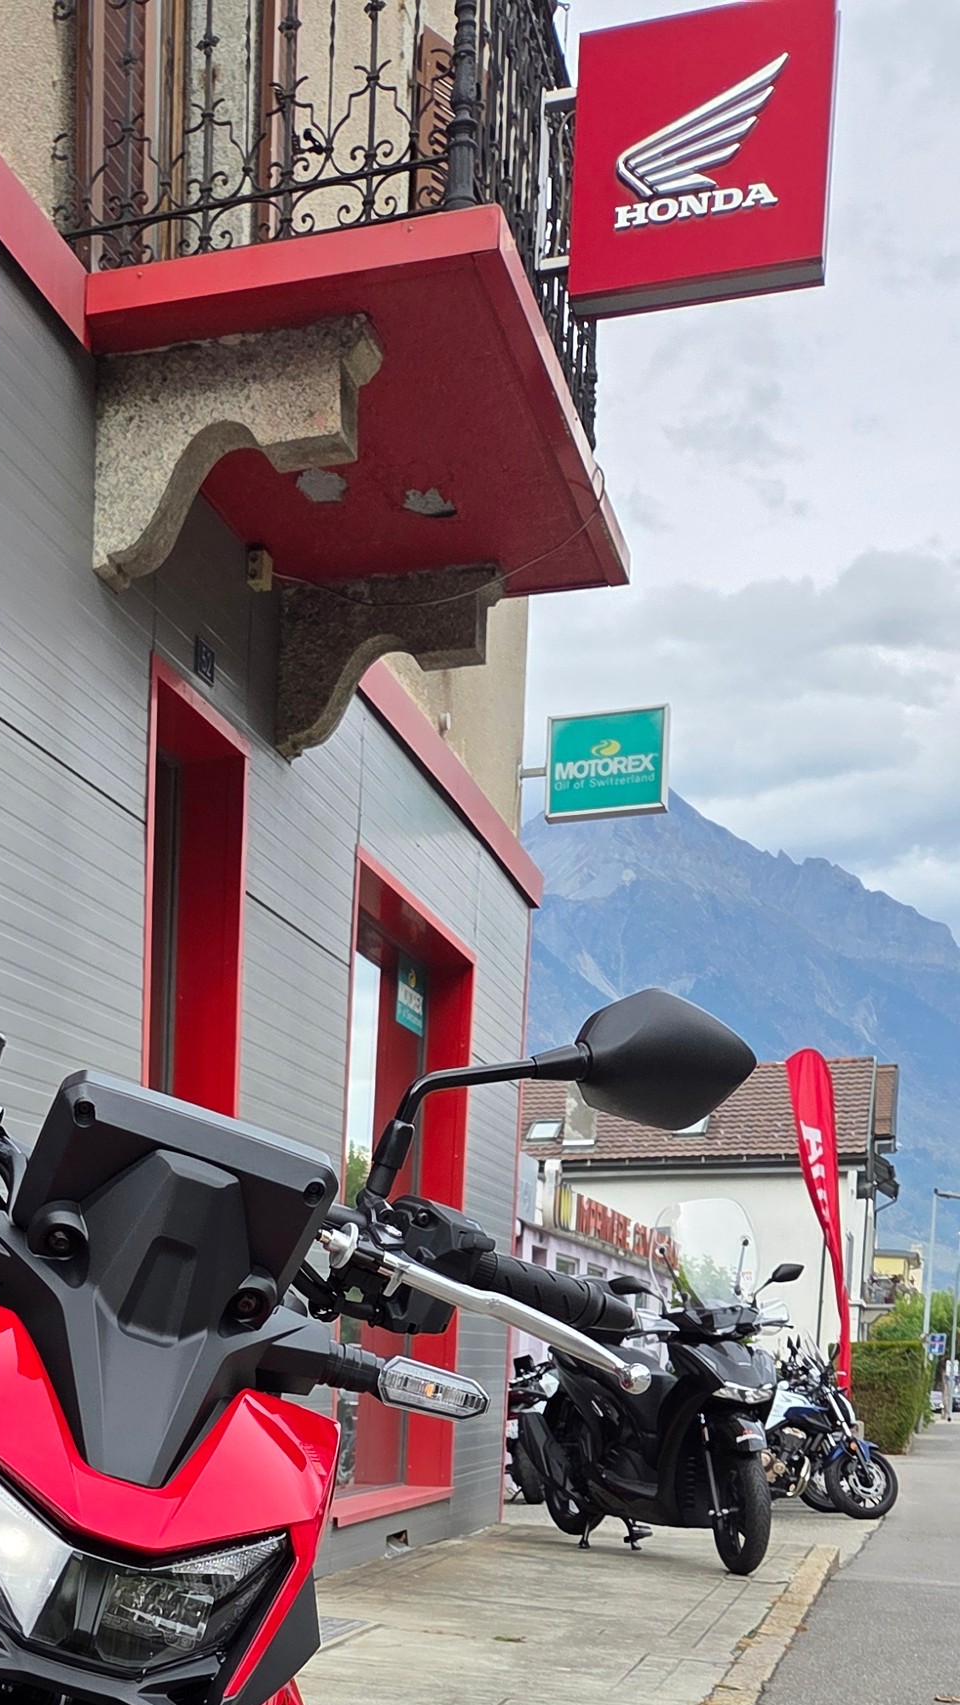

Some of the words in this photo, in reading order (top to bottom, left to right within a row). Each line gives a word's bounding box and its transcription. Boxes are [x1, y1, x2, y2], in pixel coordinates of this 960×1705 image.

[613, 182, 778, 230] HONDA
[554, 753, 656, 781] MOTOREX
[554, 779, 570, 792] Oil
[573, 779, 585, 790] of
[589, 772, 656, 789] Switzerland
